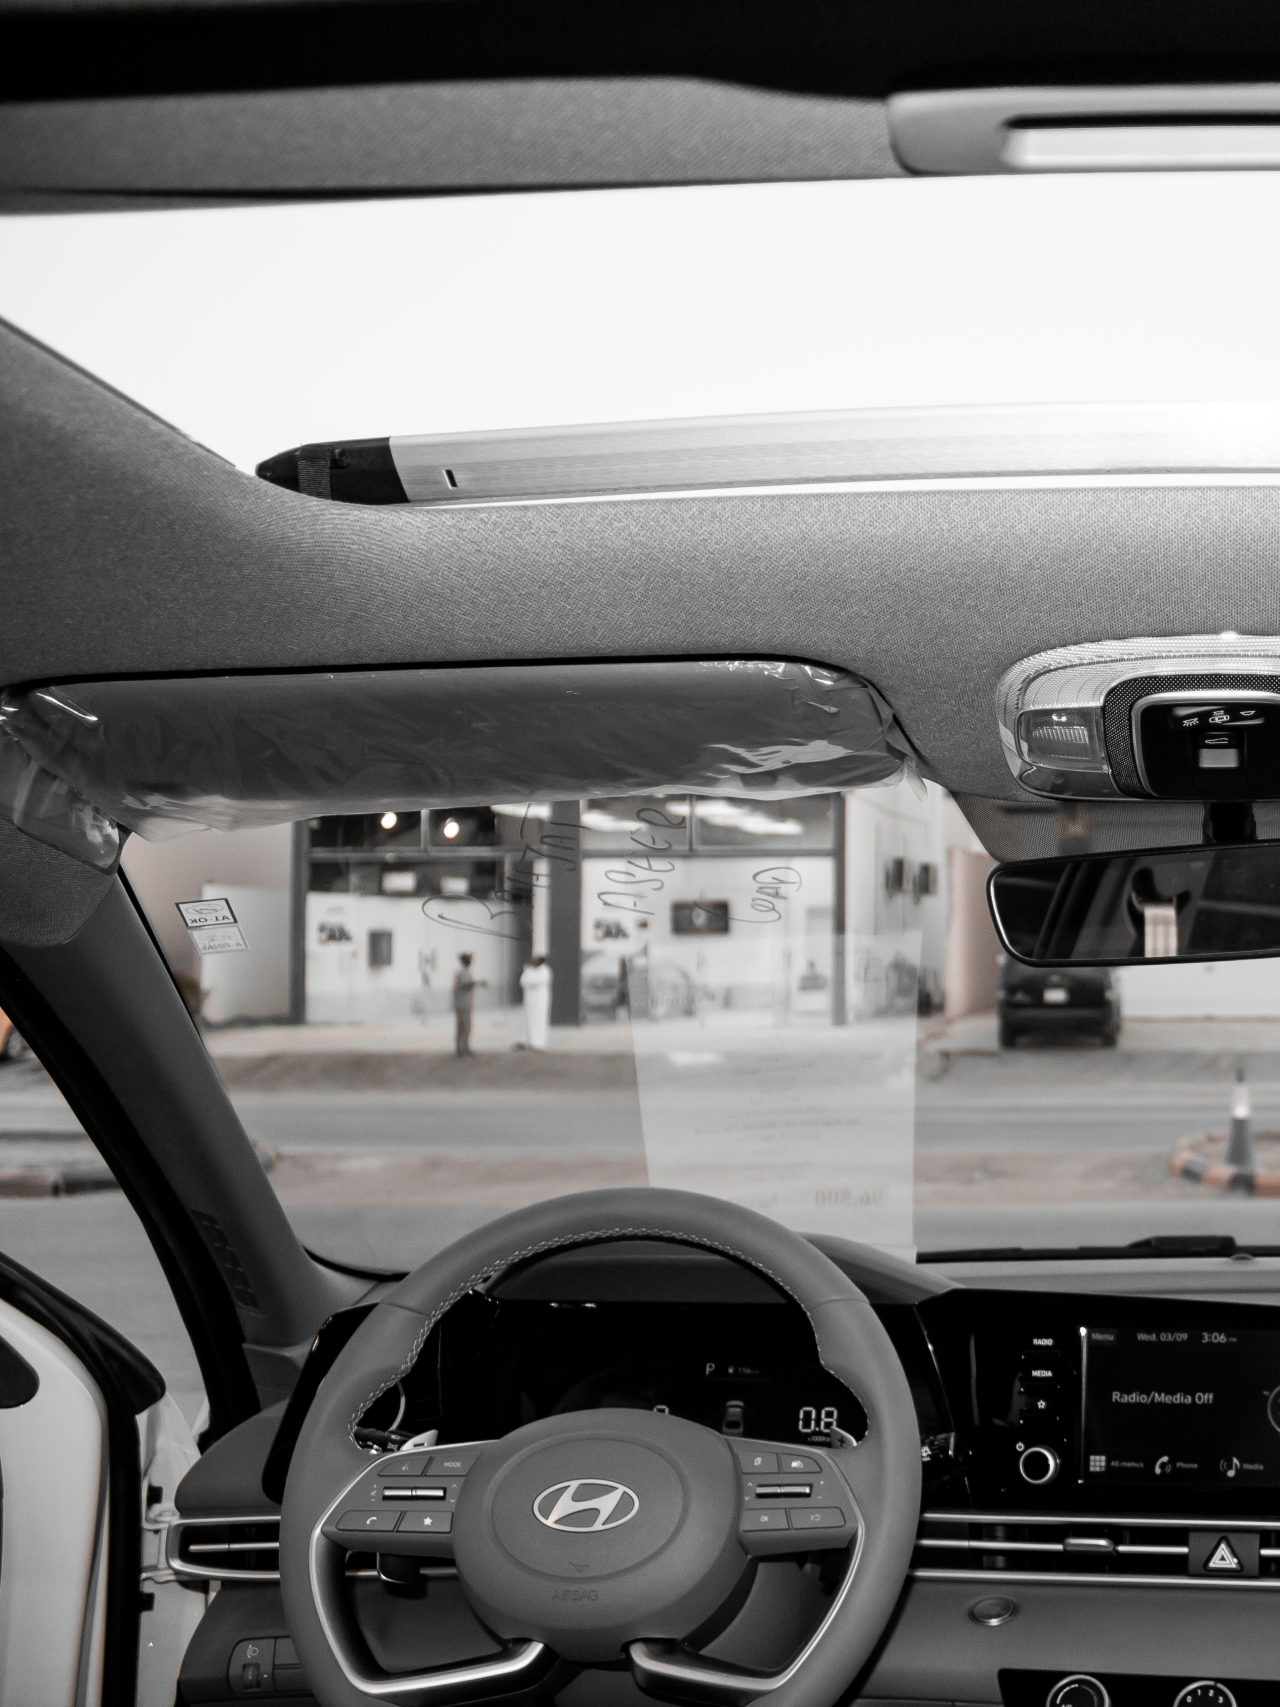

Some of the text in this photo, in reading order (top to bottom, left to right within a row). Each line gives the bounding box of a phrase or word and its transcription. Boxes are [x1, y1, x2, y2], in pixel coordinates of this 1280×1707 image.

[1032, 1338, 1053, 1346] RADIO
[1091, 1332, 1115, 1342] Menu
[1159, 1332, 1188, 1342] 03/09
[1200, 1331, 1227, 1344] 3:06
[706, 1363, 715, 1375] P
[1031, 1369, 1053, 1378] MEDIA
[1111, 1391, 1214, 1405] Radio/Media Off
[798, 1406, 838, 1433] 0.8
[1175, 1461, 1198, 1469] Phone
[1242, 1463, 1265, 1471] Media
[759, 1515, 769, 1523] OK
[551, 1589, 600, 1602] AIRBAG
